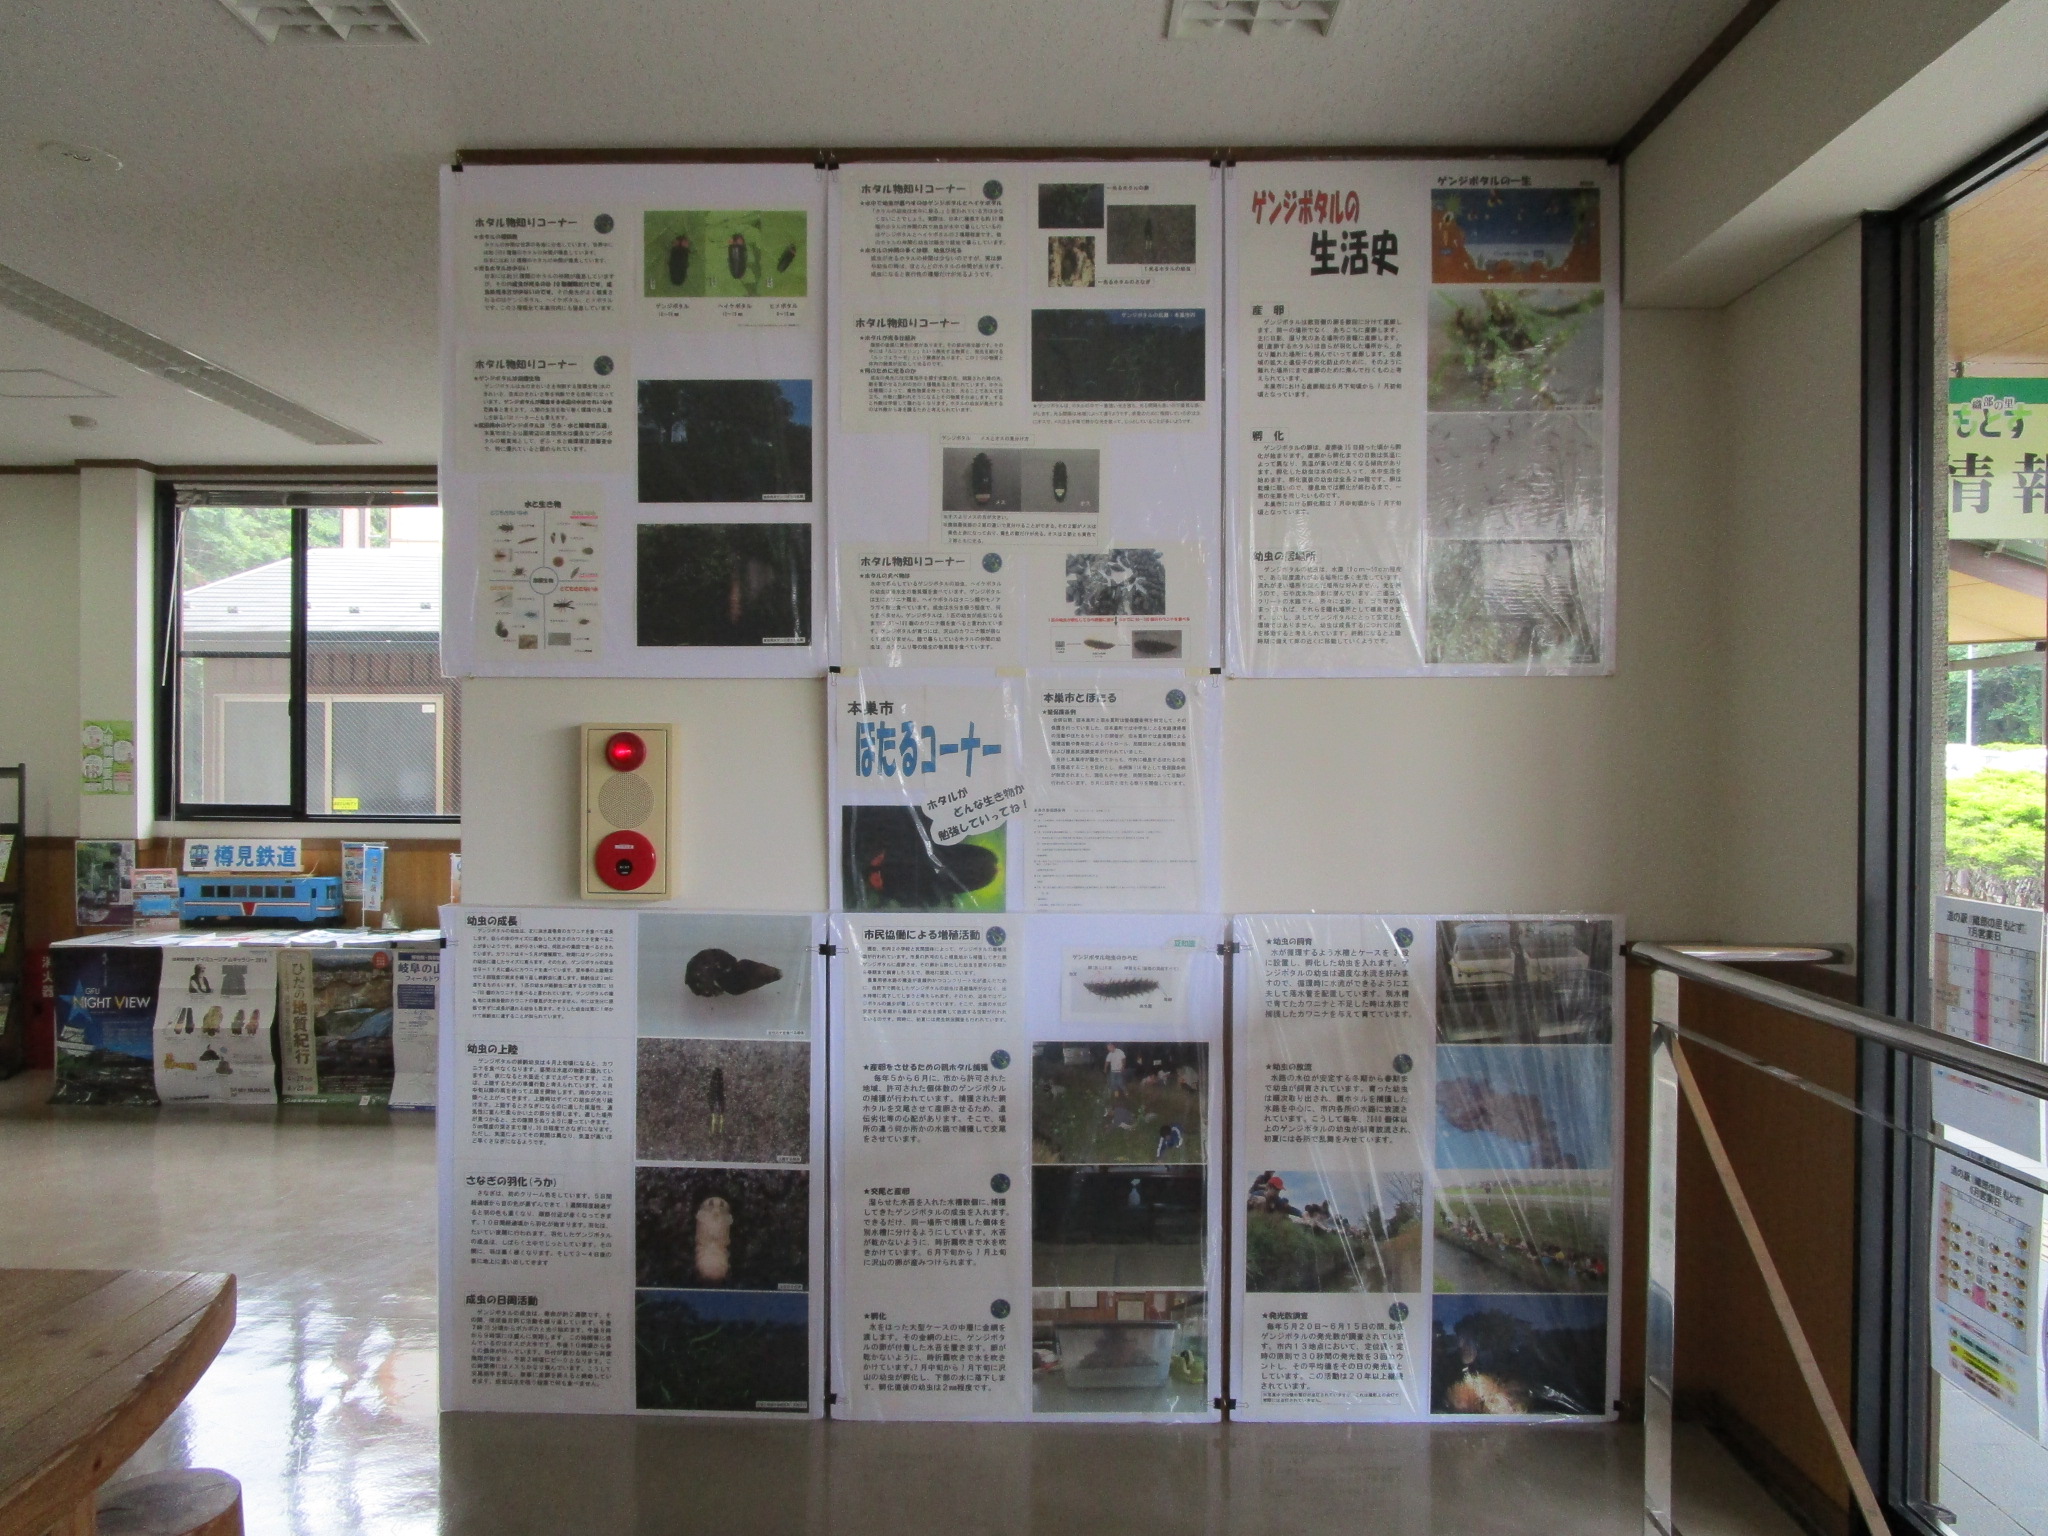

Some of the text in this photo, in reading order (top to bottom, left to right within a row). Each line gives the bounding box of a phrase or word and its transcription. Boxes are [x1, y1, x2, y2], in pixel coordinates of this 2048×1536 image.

[1437, 176, 1531, 186] ゲンジボタルの一生
[861, 184, 966, 194] ホタル物知りコーナー
[1252, 190, 1359, 224] ゲンジボタルの
[475, 217, 577, 227] ホタル物知りコーナー
[1310, 229, 1399, 276] 生活史
[1252, 305, 1284, 315] 産 卵
[855, 318, 960, 328] ホタル物知りコーナー
[475, 360, 577, 369] ホタル物知りコーナー
[1953, 404, 2032, 438] もとす
[524, 500, 561, 509] 水と生き物
[861, 557, 965, 566] ホタル物知りコーナー
[848, 701, 894, 715] 本巣市
[856, 720, 1001, 777] ほたるコーナー
[927, 787, 968, 810] ホタルが
[954, 785, 1024, 818] どんな生き物か
[938, 799, 1028, 841] 勉強していってね！
[215, 844, 297, 868] 樽見鉄道
[467, 916, 517, 926] 幼虫の成長
[864, 929, 980, 940] 市民協働による増殖活動
[73, 996, 151, 1009] NIGHT VIEW
[292, 963, 310, 1064] ひだの地質紀行
[467, 1044, 518, 1055] 幼虫の上陸
[1273, 1063, 1312, 1071] 幼虫の放流
[863, 1135, 921, 1143] をさせています。
[466, 1176, 556, 1187] さなぎの羽化(うか)
